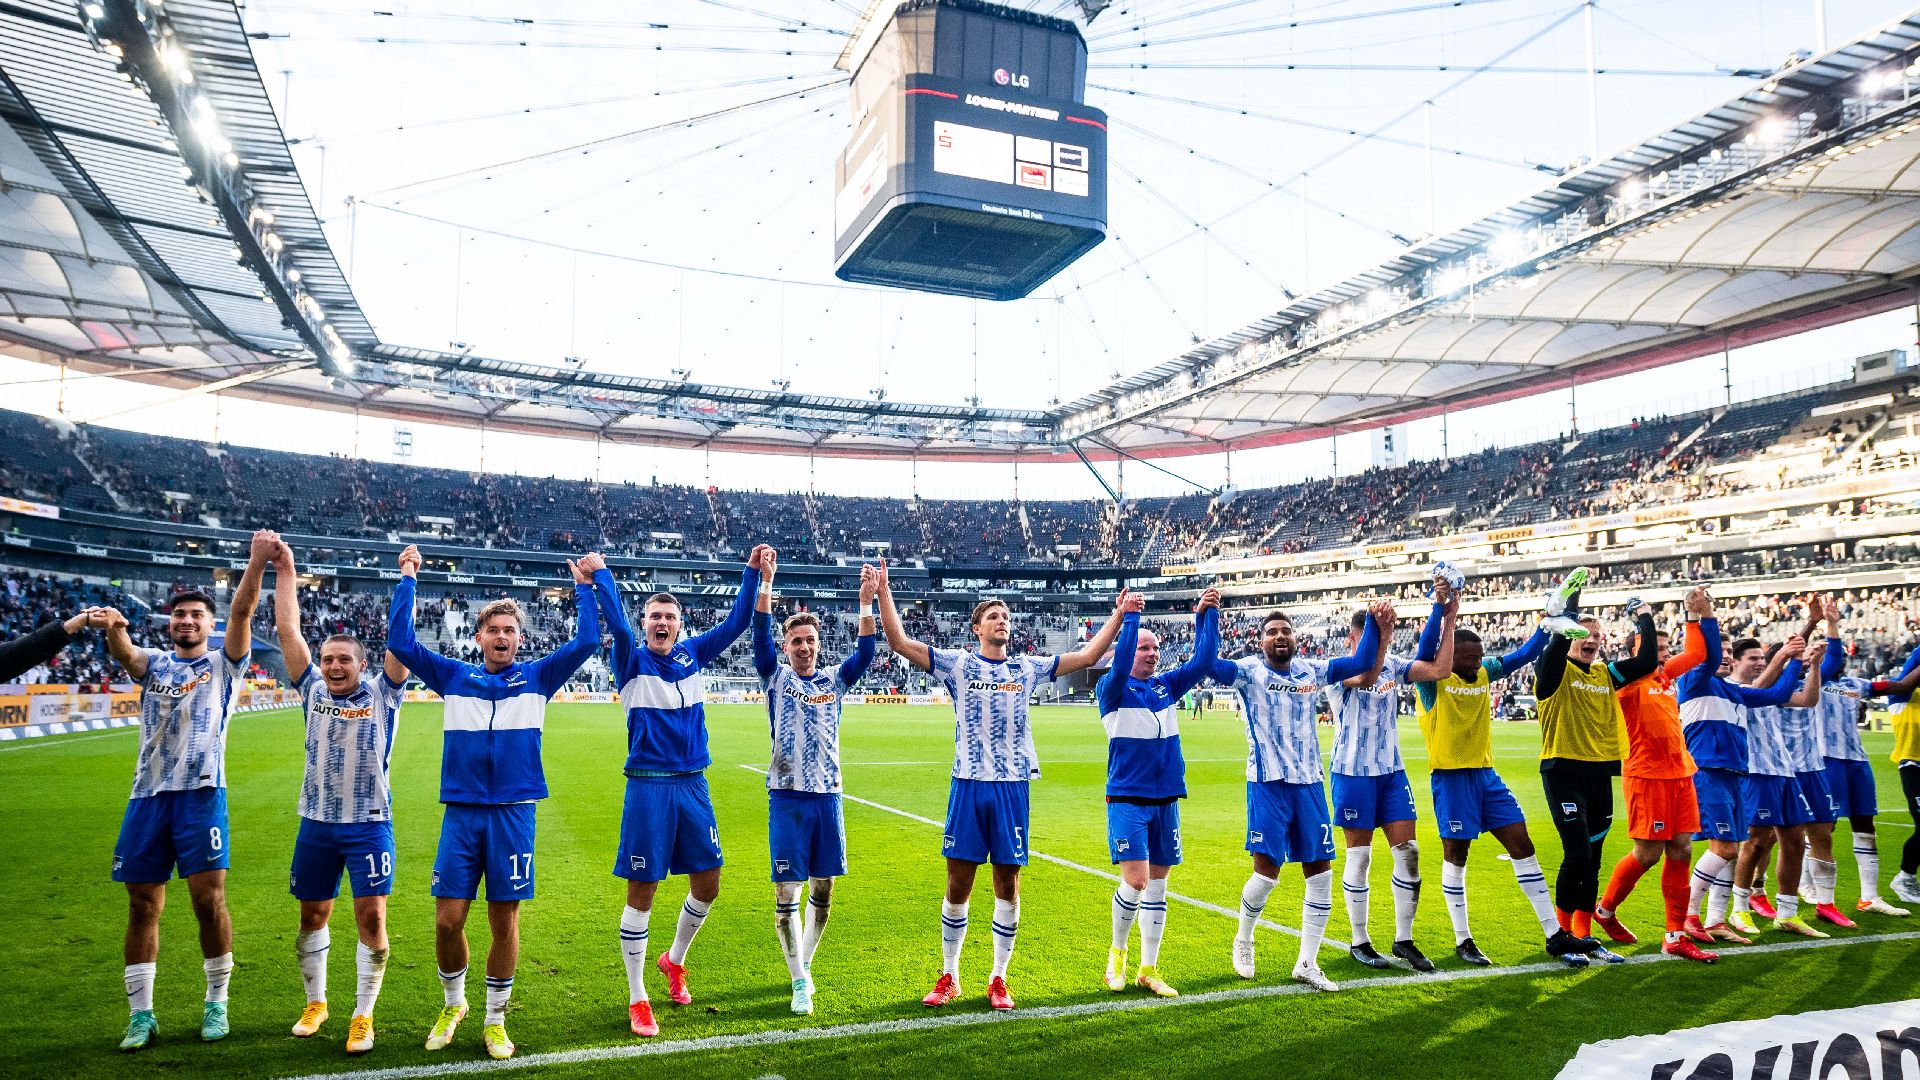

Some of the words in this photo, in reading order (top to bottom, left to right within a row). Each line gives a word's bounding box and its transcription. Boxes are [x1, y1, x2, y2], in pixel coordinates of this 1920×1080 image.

[1012, 73, 1029, 88] LG
[1488, 529, 1533, 541] HORN
[1366, 545, 1404, 555] HORN
[152, 553, 185, 565] Indeed
[230, 560, 249, 569] Inde
[306, 566, 337, 575] Indeed
[1163, 567, 1197, 575] HORN
[447, 574, 475, 584] Indeed
[512, 578, 538, 587] Indeed
[668, 585, 693, 593] Indeed
[814, 590, 837, 598] Indeed
[1089, 594, 1109, 602] Indeed
[968, 682, 1023, 693] AUTOHERO
[1267, 683, 1317, 694] AUTOHERO
[785, 687, 835, 704] AUTOHERO
[0, 704, 28, 724] RN
[210, 826, 222, 851] 8
[709, 825, 720, 849] 4
[1014, 826, 1023, 849] 5
[365, 851, 392, 878] 18
[509, 853, 533, 880] 17
